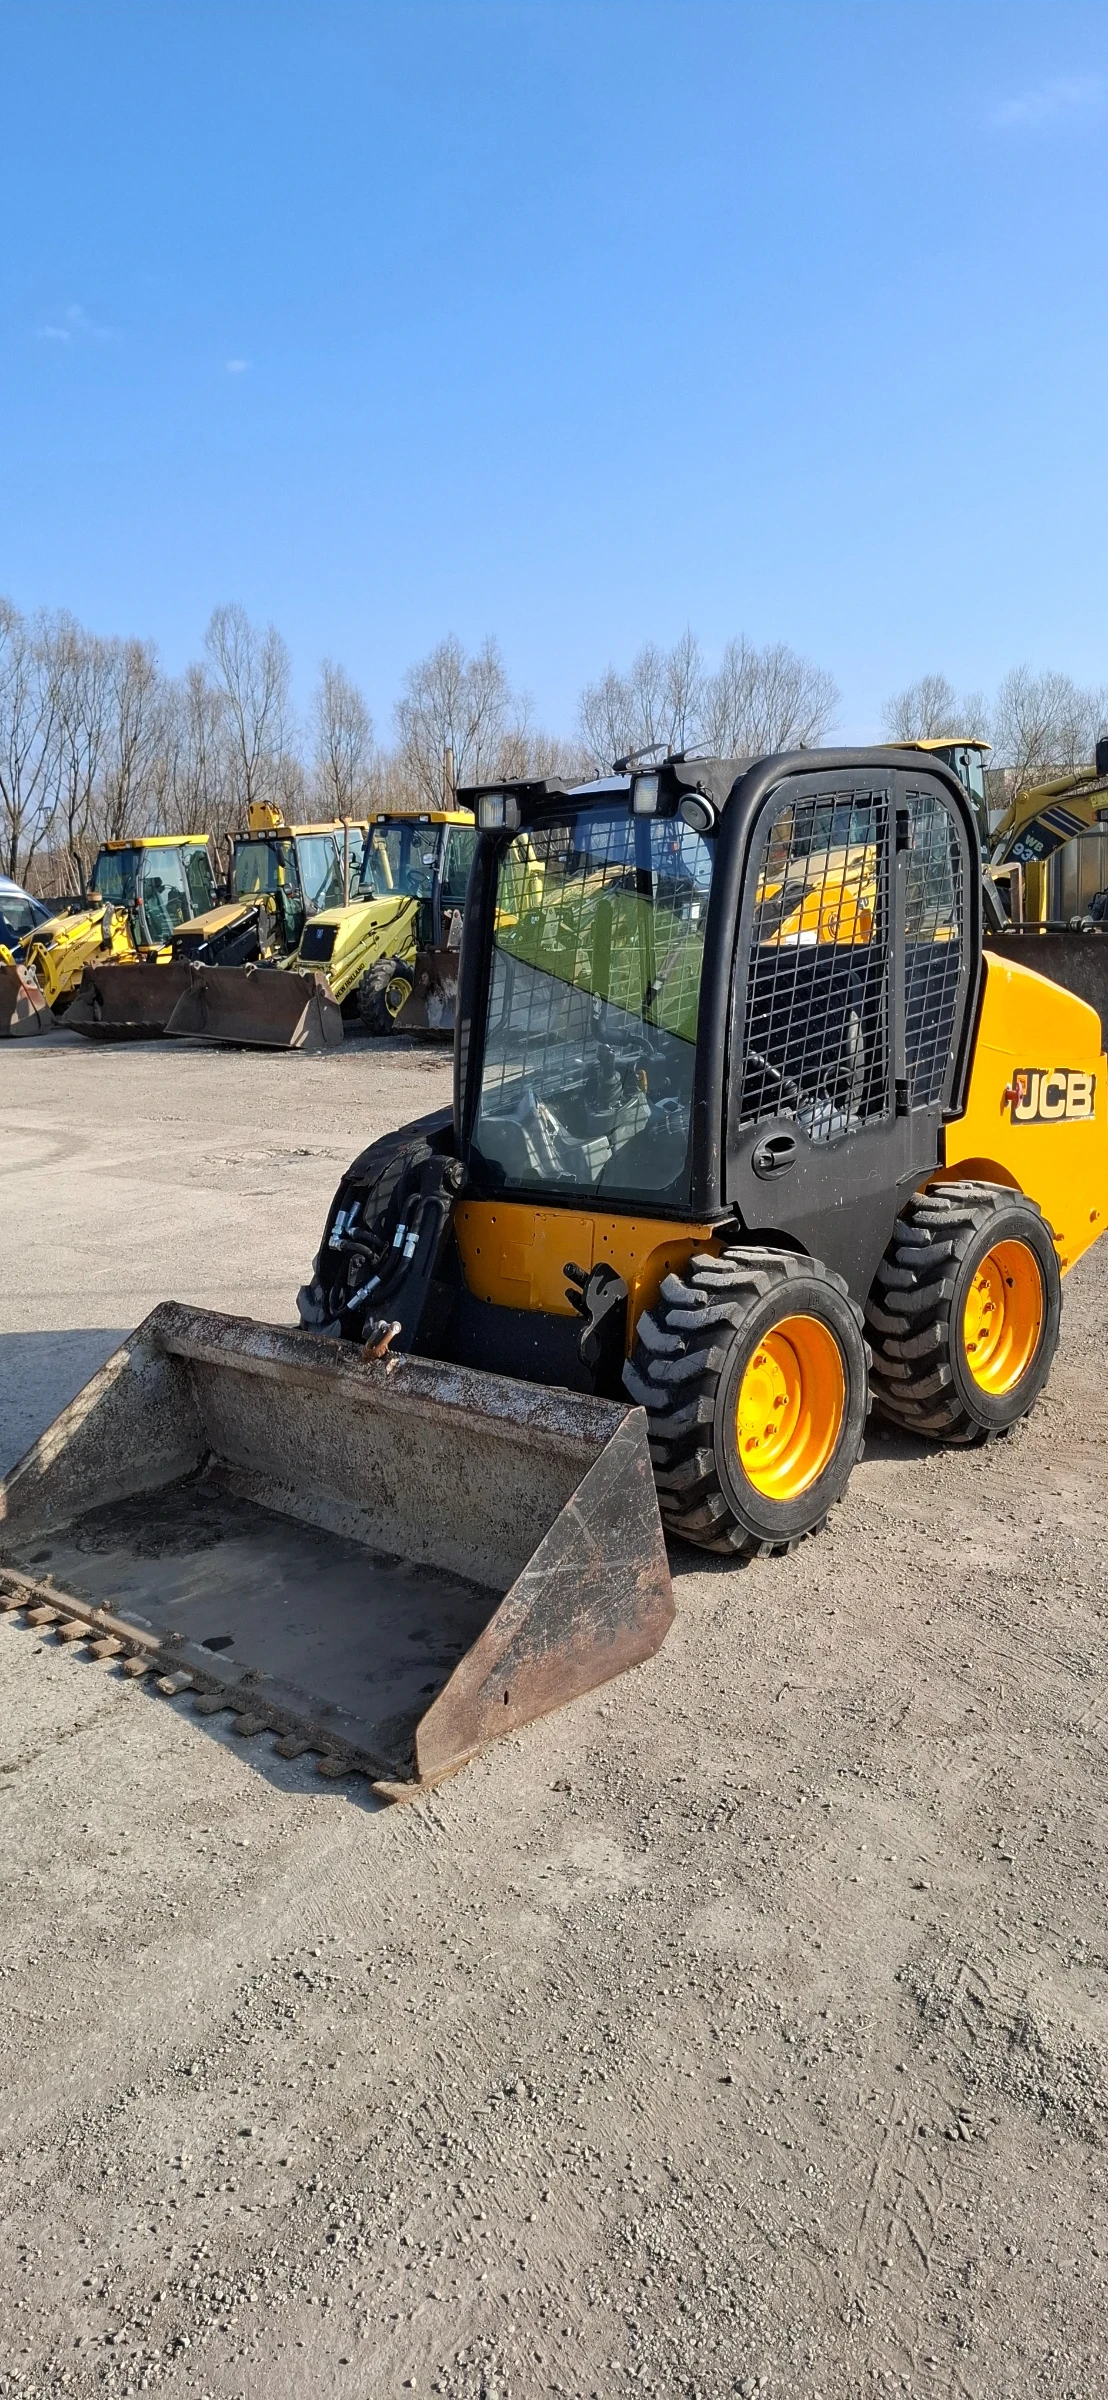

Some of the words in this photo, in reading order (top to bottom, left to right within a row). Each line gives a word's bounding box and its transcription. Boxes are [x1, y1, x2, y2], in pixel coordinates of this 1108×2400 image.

[1025, 834, 1044, 852] WB
[335, 985, 347, 1000] NEW
[345, 963, 365, 988] HOLLAND
[1015, 1073, 1093, 1120] JCB
